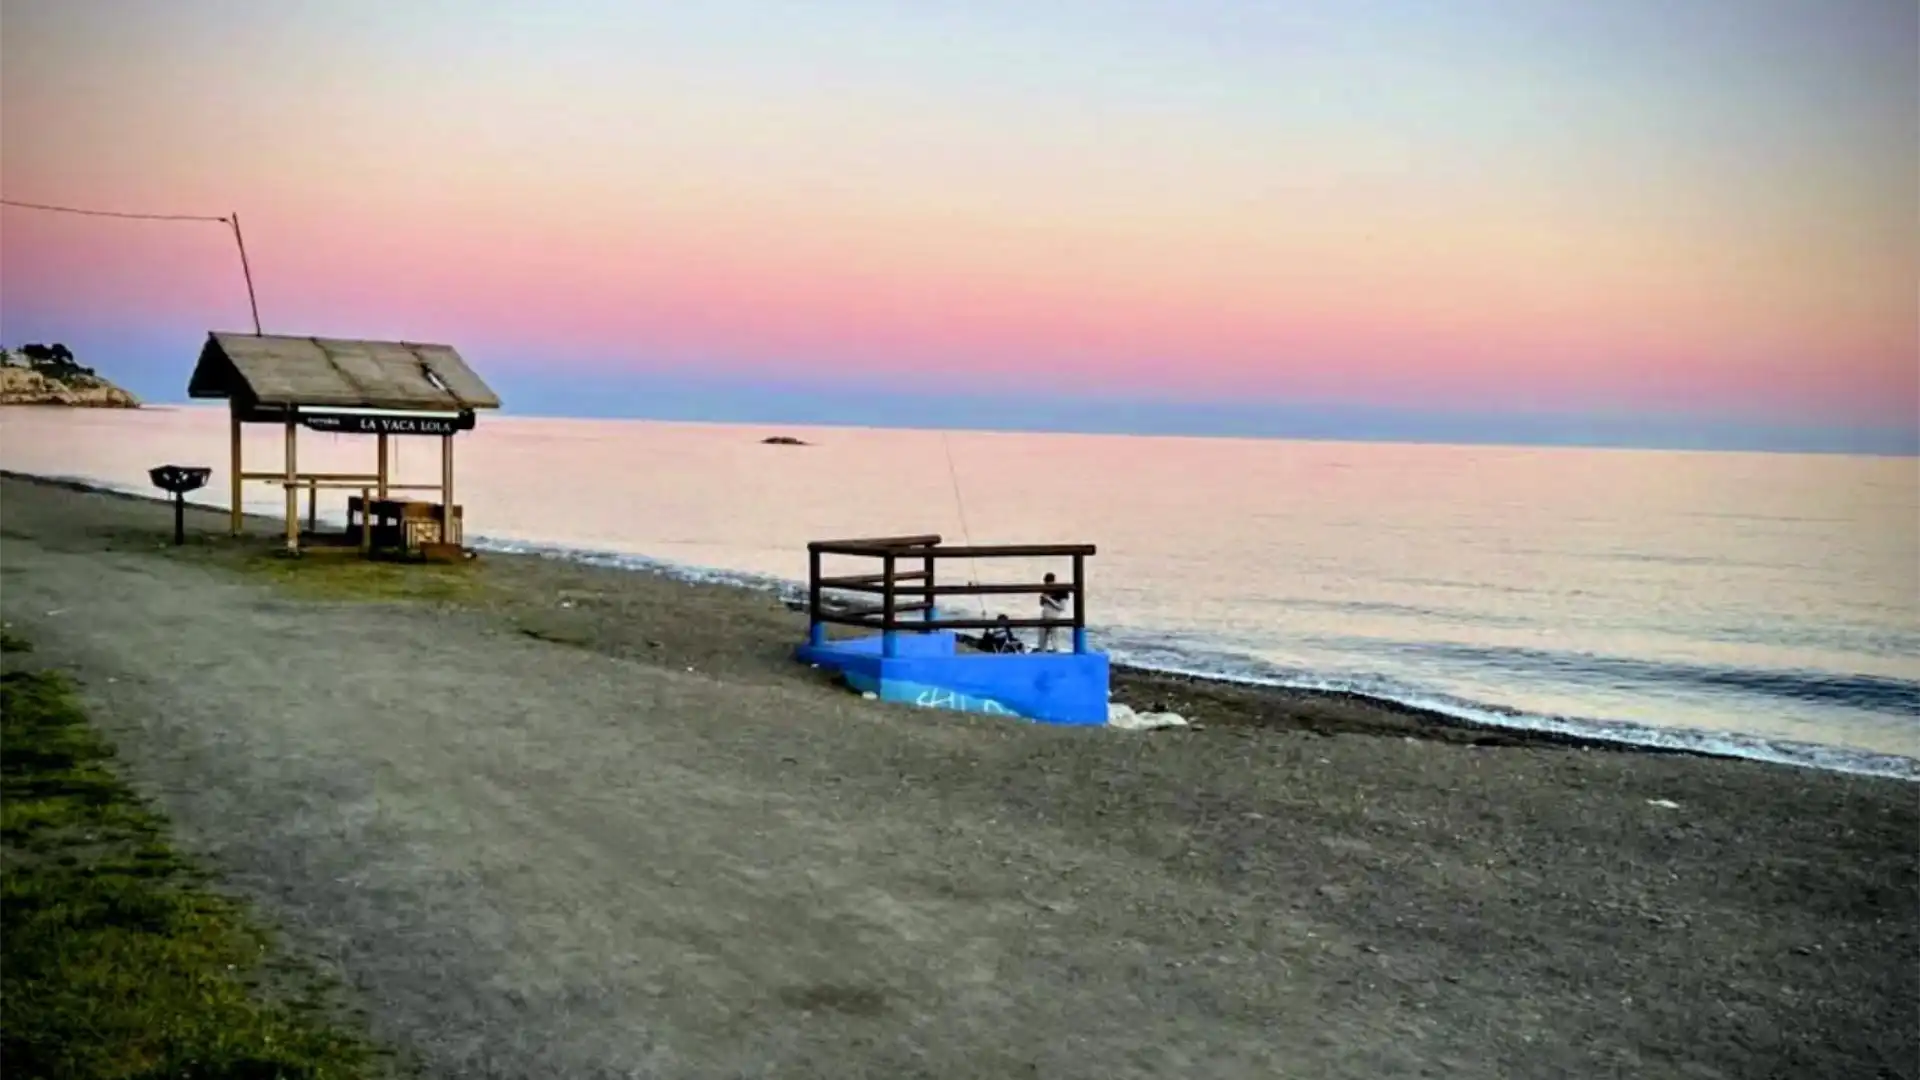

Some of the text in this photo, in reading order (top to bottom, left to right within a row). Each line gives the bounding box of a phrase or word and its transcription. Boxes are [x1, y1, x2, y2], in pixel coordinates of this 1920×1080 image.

[360, 418, 452, 432] LA VACA LOLA
